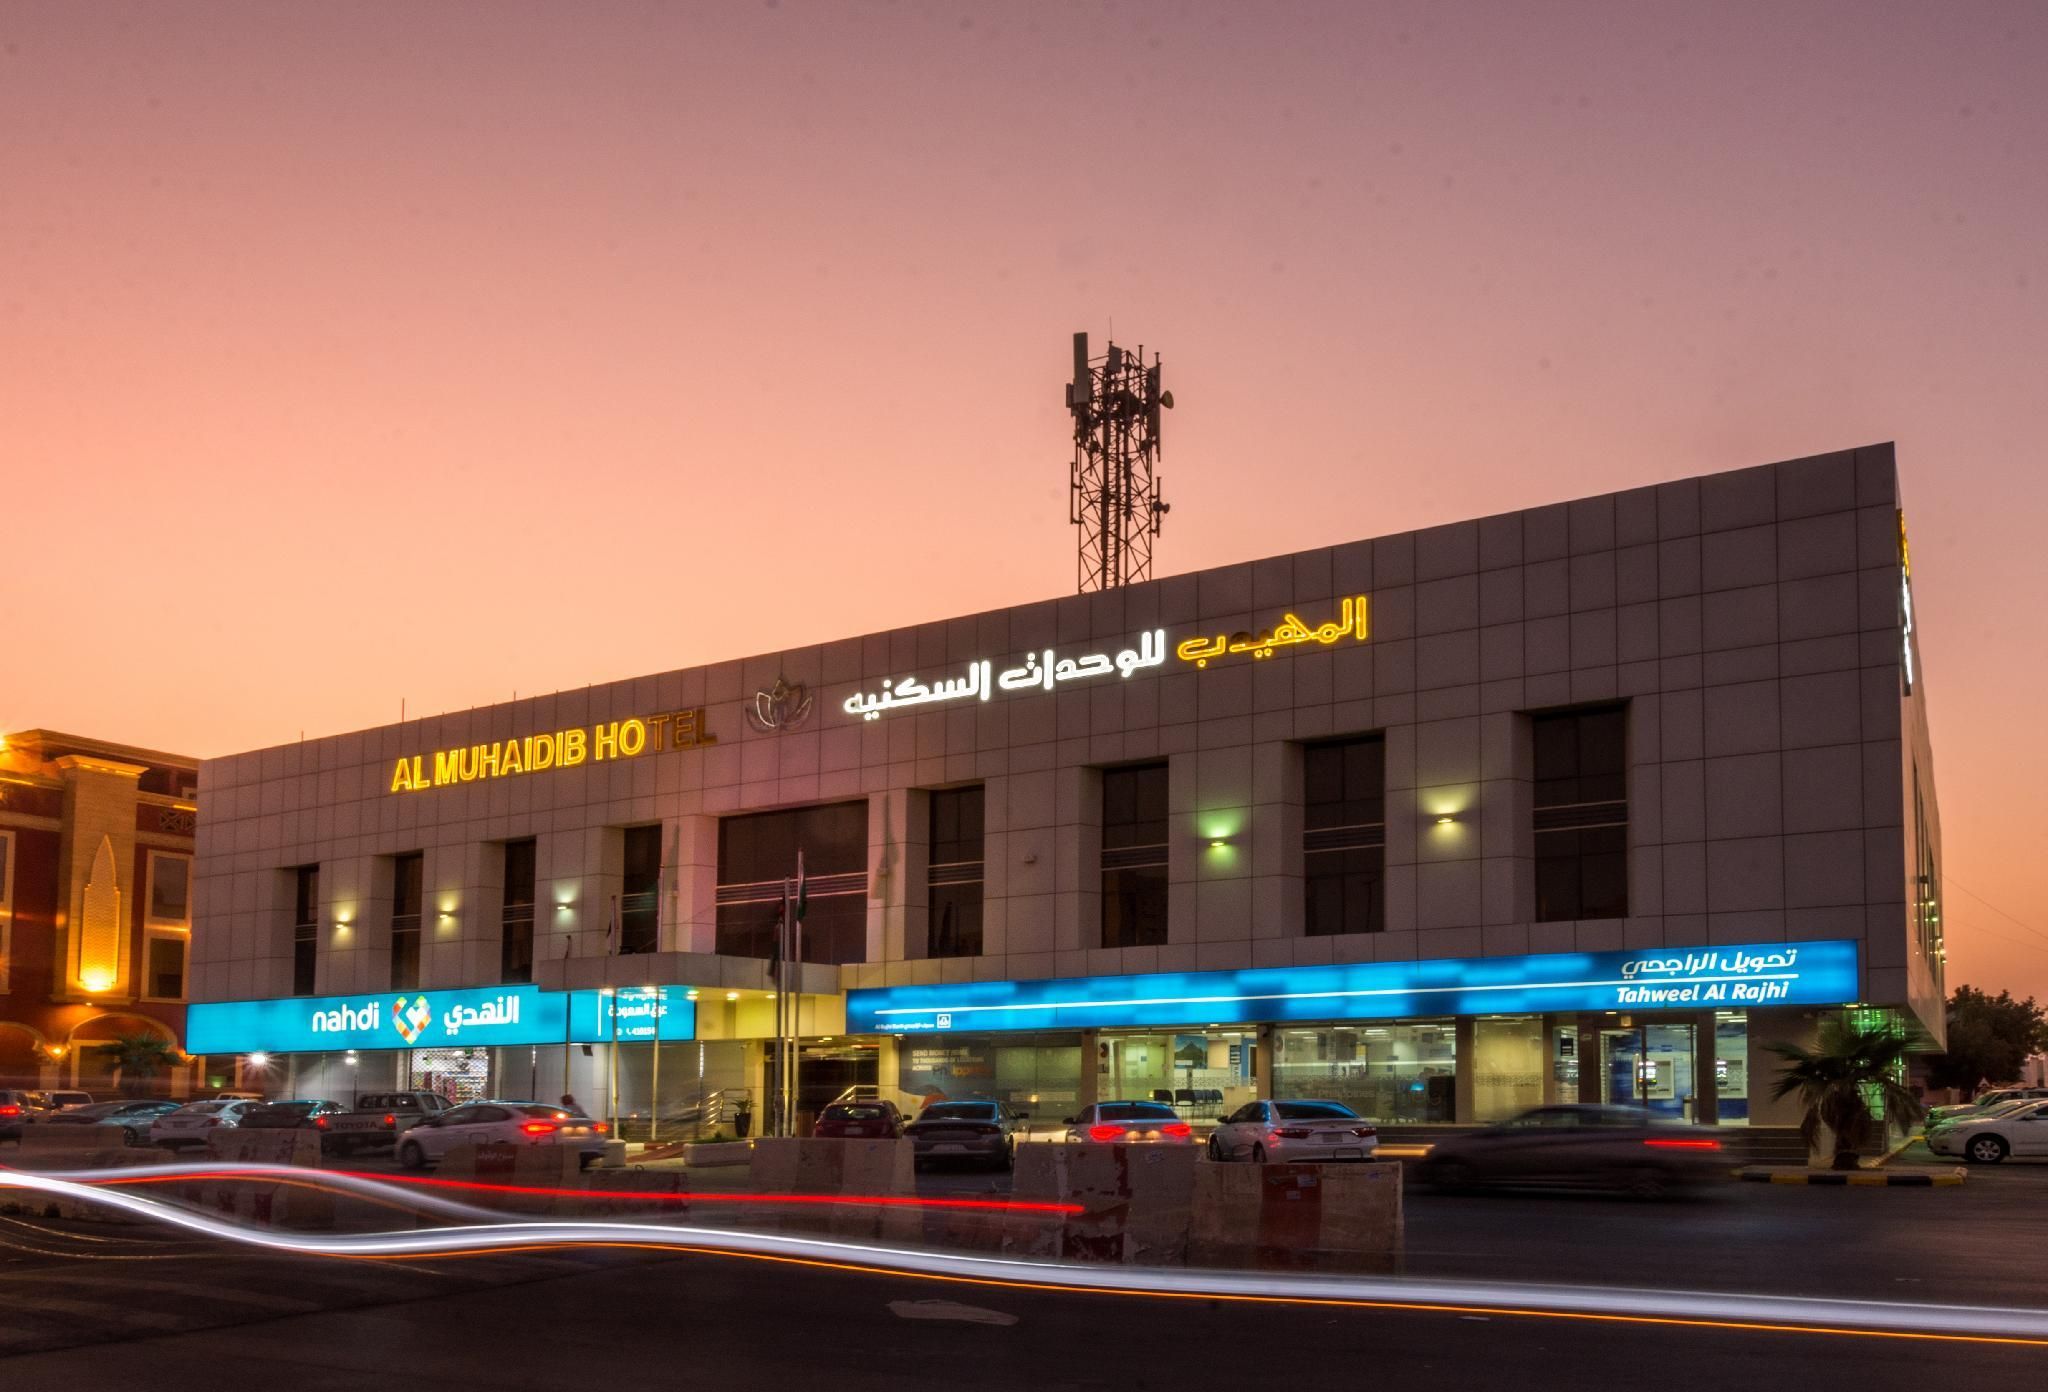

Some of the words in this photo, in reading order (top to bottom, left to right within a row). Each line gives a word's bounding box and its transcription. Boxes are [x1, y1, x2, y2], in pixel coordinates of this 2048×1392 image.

[1176, 597, 1368, 668] المهيدب
[998, 629, 1166, 691] للوحدات
[391, 757, 430, 792] AL
[433, 728, 587, 785] MUHAIDIB
[595, 708, 718, 760] HOTEL
[1621, 952, 1717, 980] الراجحي
[1720, 948, 1798, 974] تحويل
[1616, 985, 1698, 1004] Tahweel
[1703, 982, 1726, 1001] Al
[1732, 980, 1790, 1004] Rajhi
[312, 1001, 380, 1033] nahdi
[443, 995, 520, 1036] النهدي
